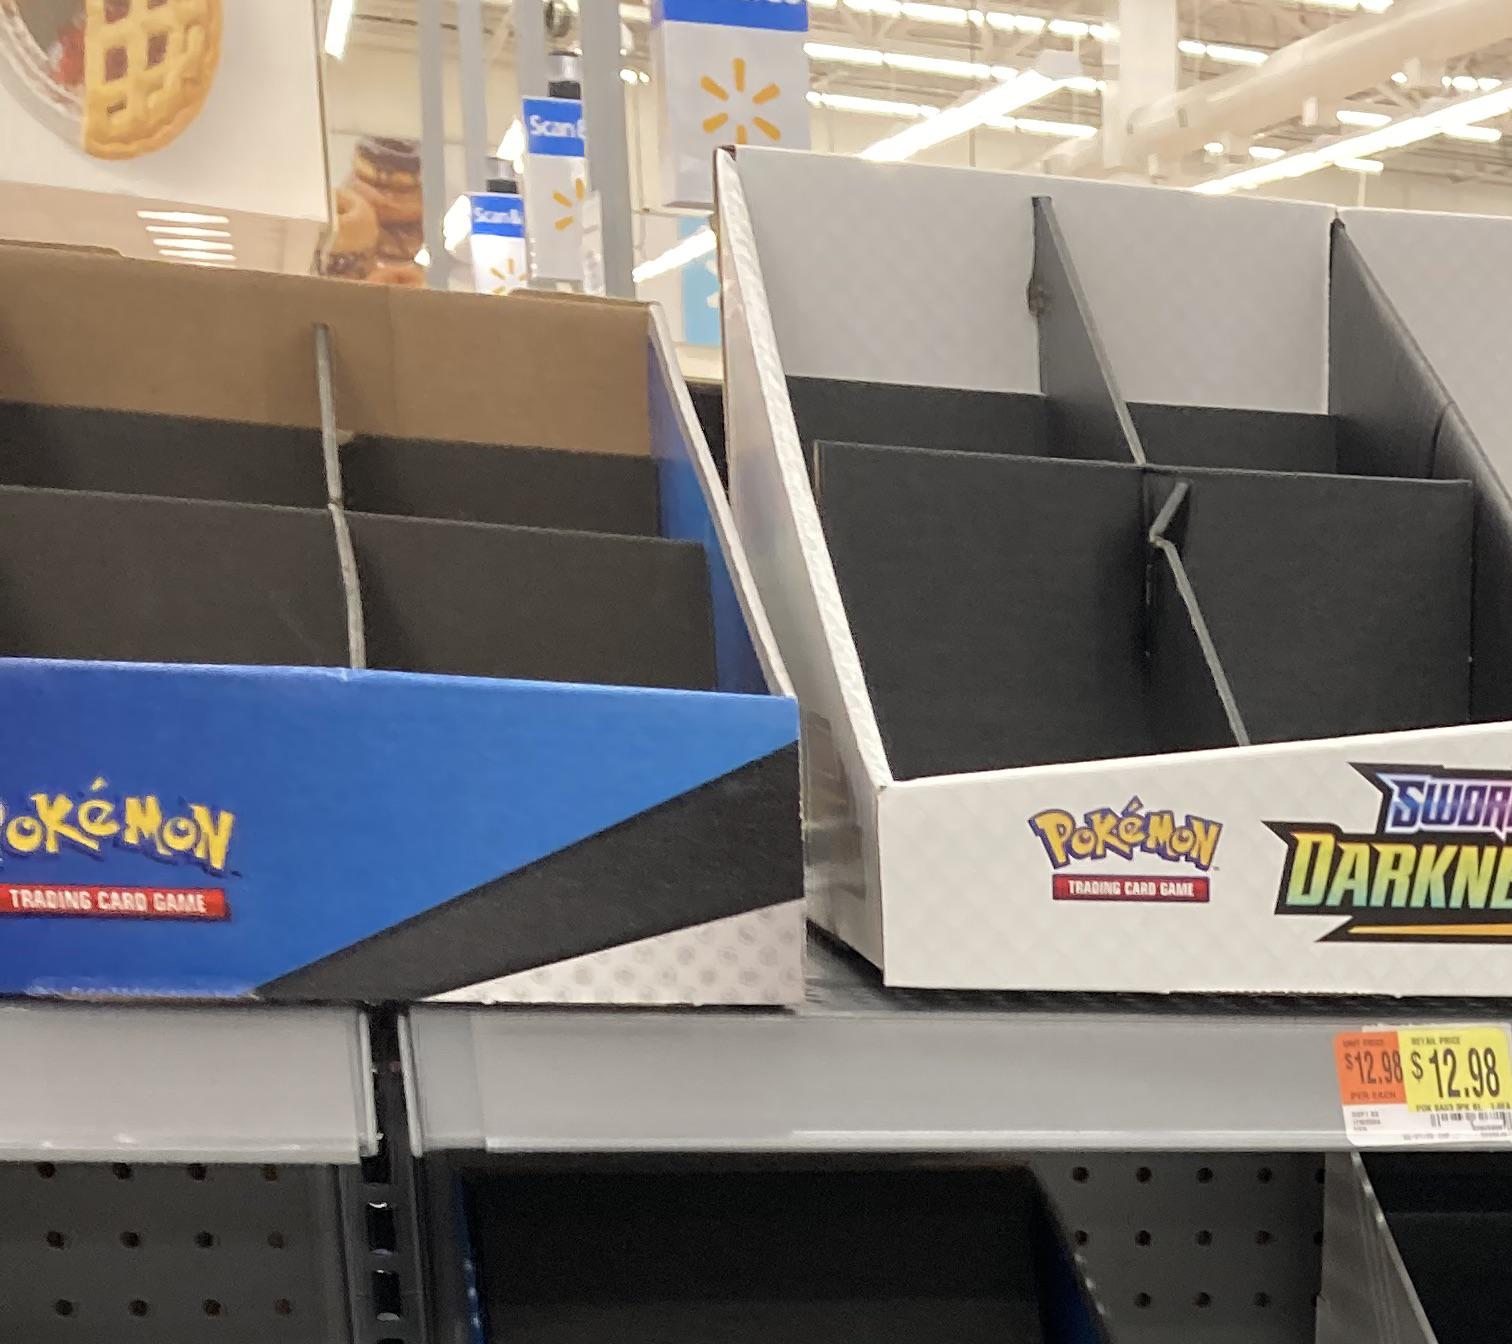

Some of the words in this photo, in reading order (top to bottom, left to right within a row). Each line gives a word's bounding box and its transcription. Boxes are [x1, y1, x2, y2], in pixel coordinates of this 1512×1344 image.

[9, 888, 91, 909] TRADING
[98, 890, 146, 911] CARD
[153, 892, 207, 913] GAME
[1068, 879, 1121, 896] TRADING
[1124, 880, 1156, 897] CARD
[1159, 882, 1194, 898] GAME
[1345, 1050, 1403, 1084] $12.98
[1411, 1047, 1500, 1098] $12.98
